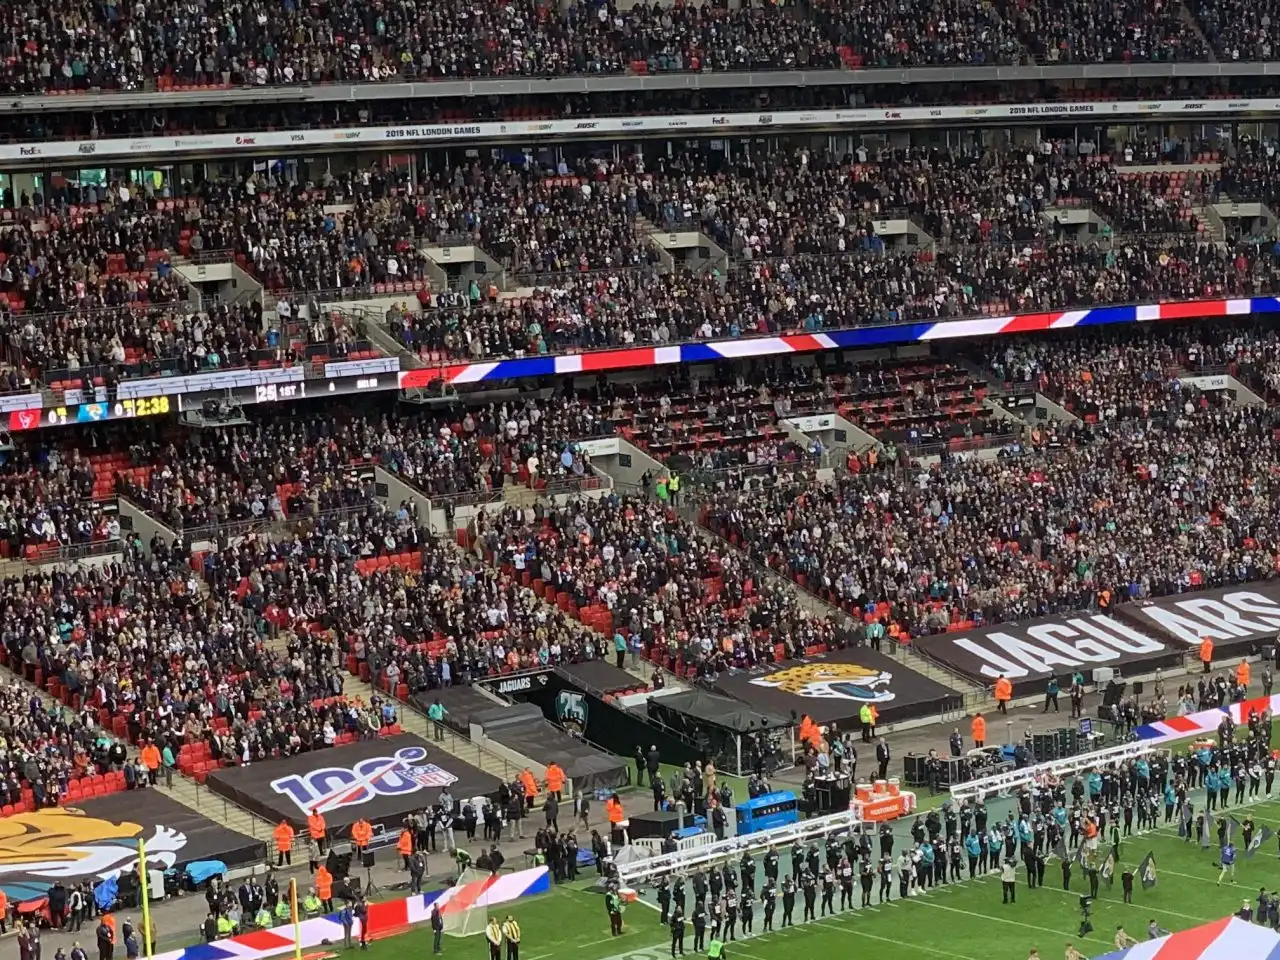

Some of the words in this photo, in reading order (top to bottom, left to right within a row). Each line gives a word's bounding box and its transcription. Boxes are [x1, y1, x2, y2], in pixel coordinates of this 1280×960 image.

[1041, 105, 1068, 113] LONDON
[1069, 105, 1094, 113] GAMES
[712, 117, 730, 125] FedEx
[291, 134, 305, 142] VISA
[386, 130, 405, 138] 2019
[406, 129, 420, 137] NFL
[422, 128, 452, 136] LONDON
[454, 126, 481, 135] GAMES
[20, 147, 42, 155] FedEx
[258, 385, 275, 401] 25
[279, 385, 297, 397] 1ST
[114, 403, 123, 416] 0
[135, 396, 170, 417] 2:38
[48, 410, 57, 424] 0
[499, 677, 531, 694] JAGUARS
